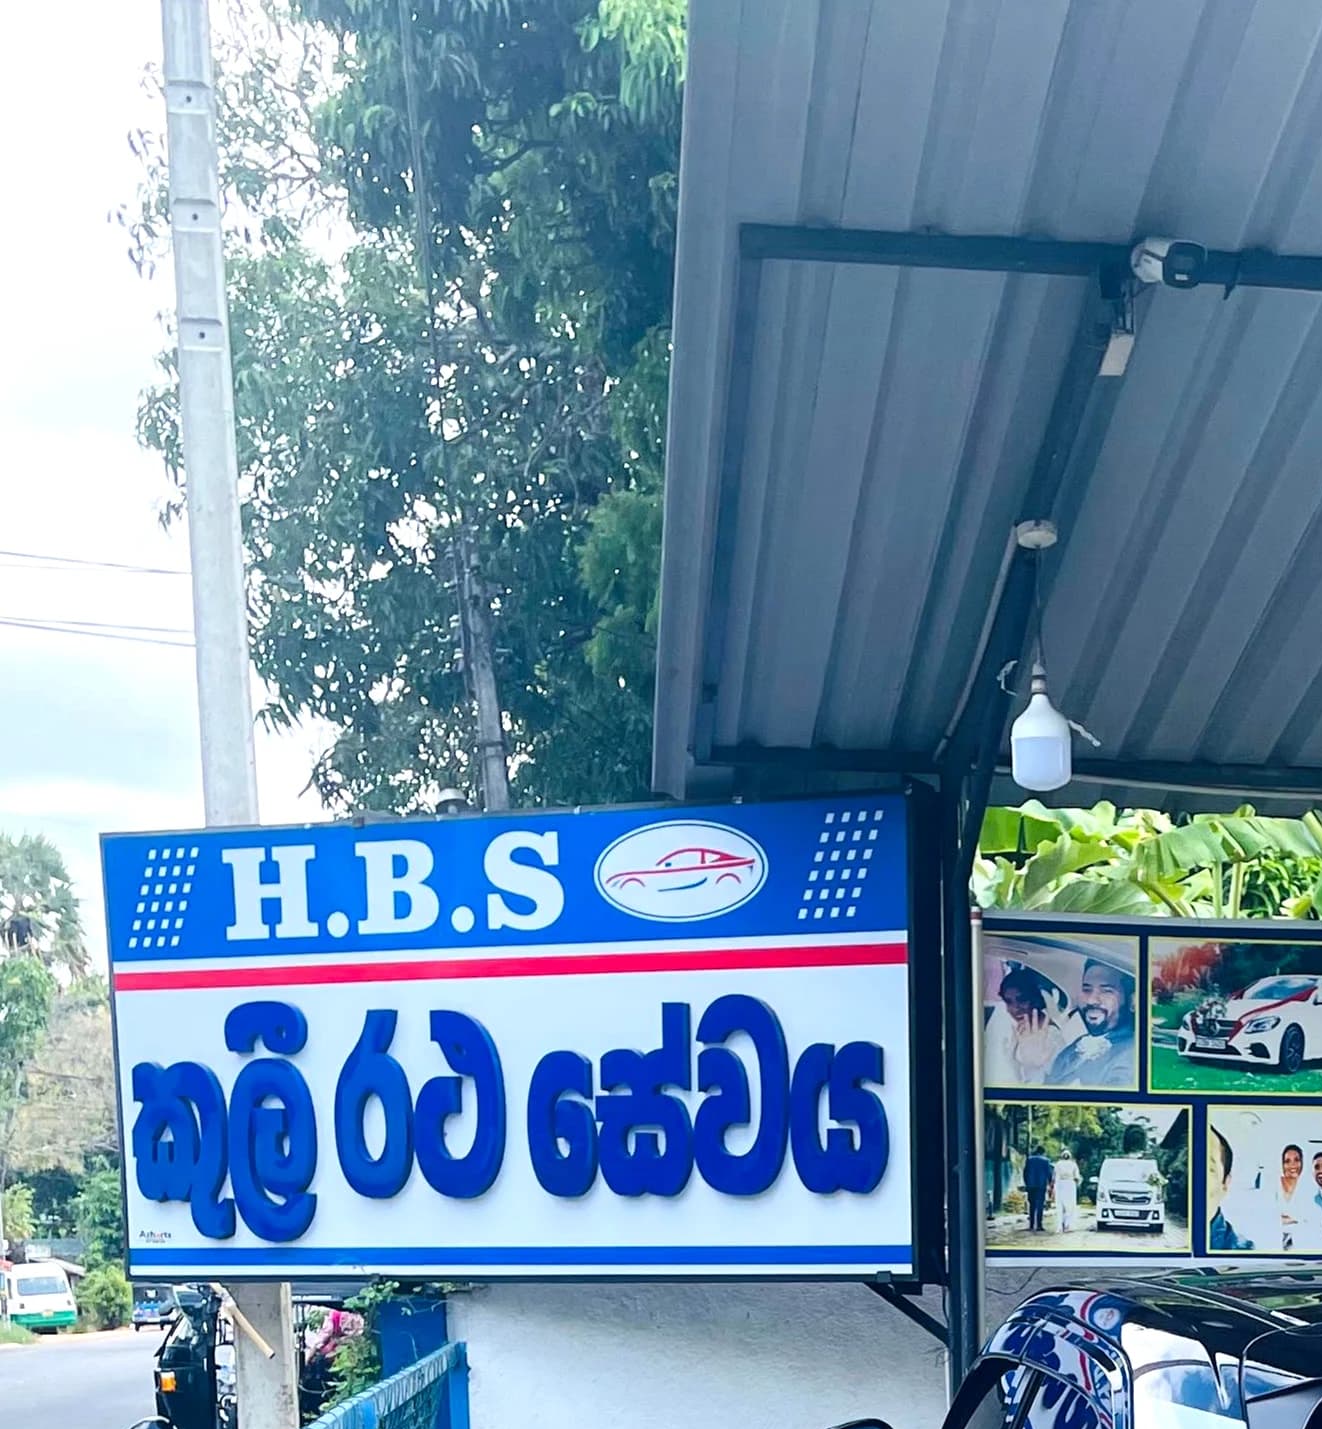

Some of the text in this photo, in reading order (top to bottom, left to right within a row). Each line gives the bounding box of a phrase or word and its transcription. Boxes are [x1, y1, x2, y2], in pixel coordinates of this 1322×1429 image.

[221, 830, 565, 941] H.B.S
[333, 1008, 508, 1199] රථ
[526, 993, 891, 1199] සේවය
